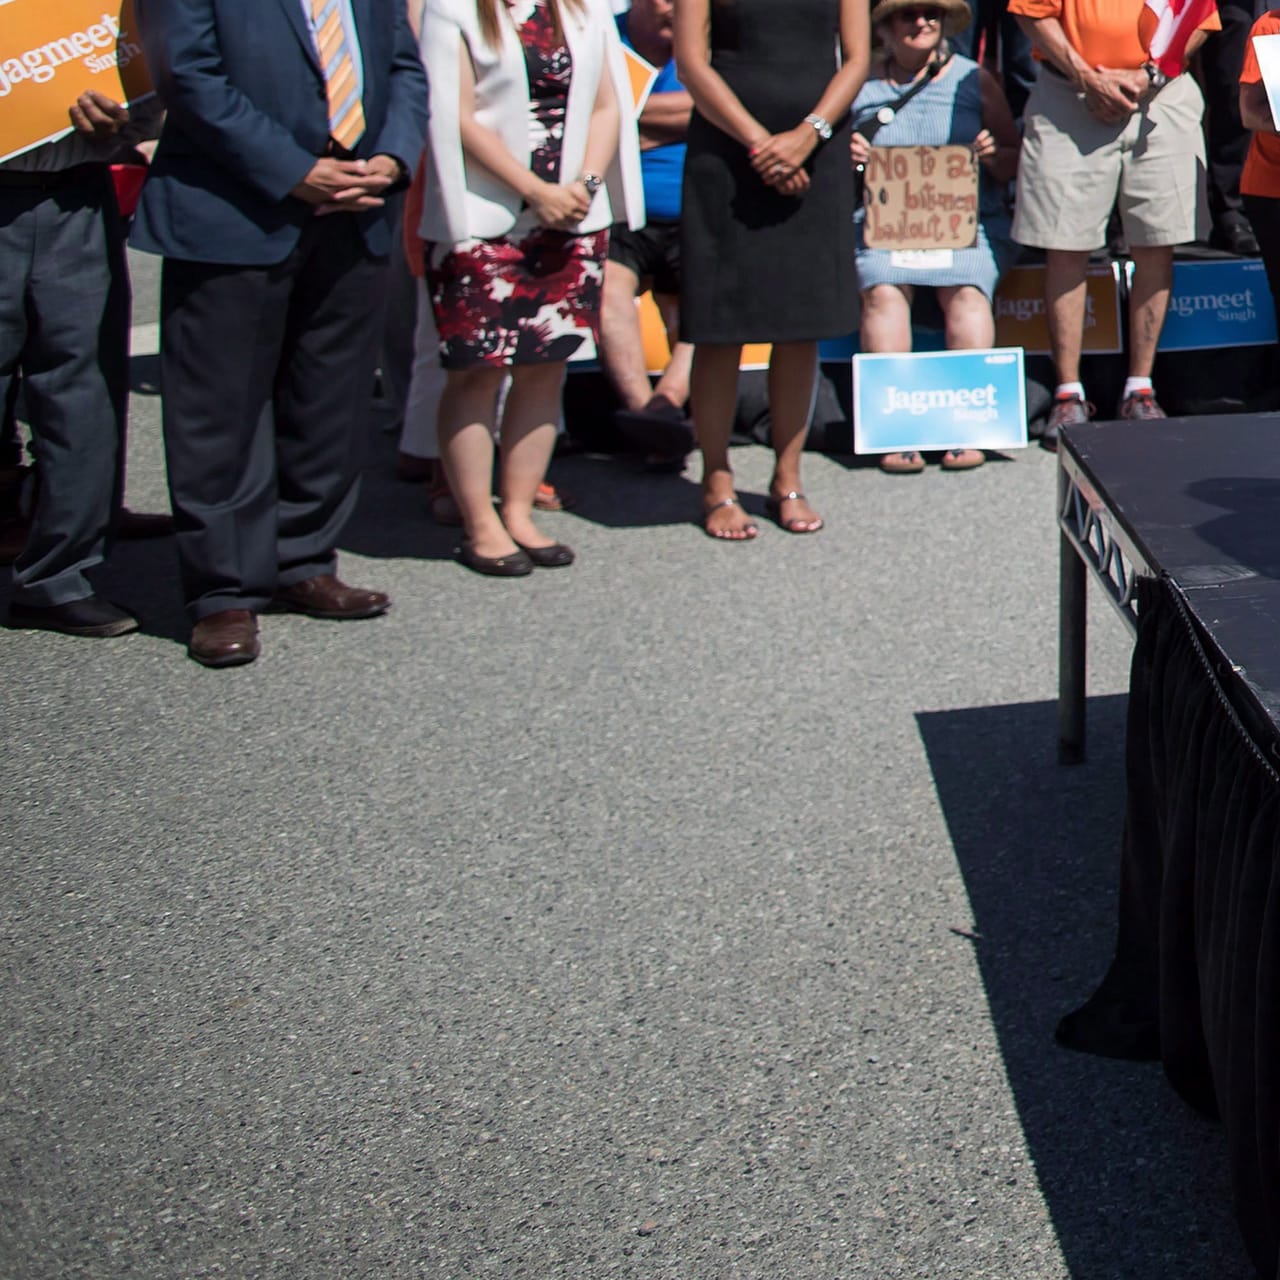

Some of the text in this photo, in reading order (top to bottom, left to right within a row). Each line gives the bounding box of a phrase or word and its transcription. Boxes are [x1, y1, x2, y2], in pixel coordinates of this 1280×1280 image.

[82, 41, 142, 75] Singh
[869, 148, 909, 181] No
[1168, 287, 1255, 319] agmeet
[1216, 310, 1257, 323] Singh
[882, 383, 998, 416] Jagmeet
